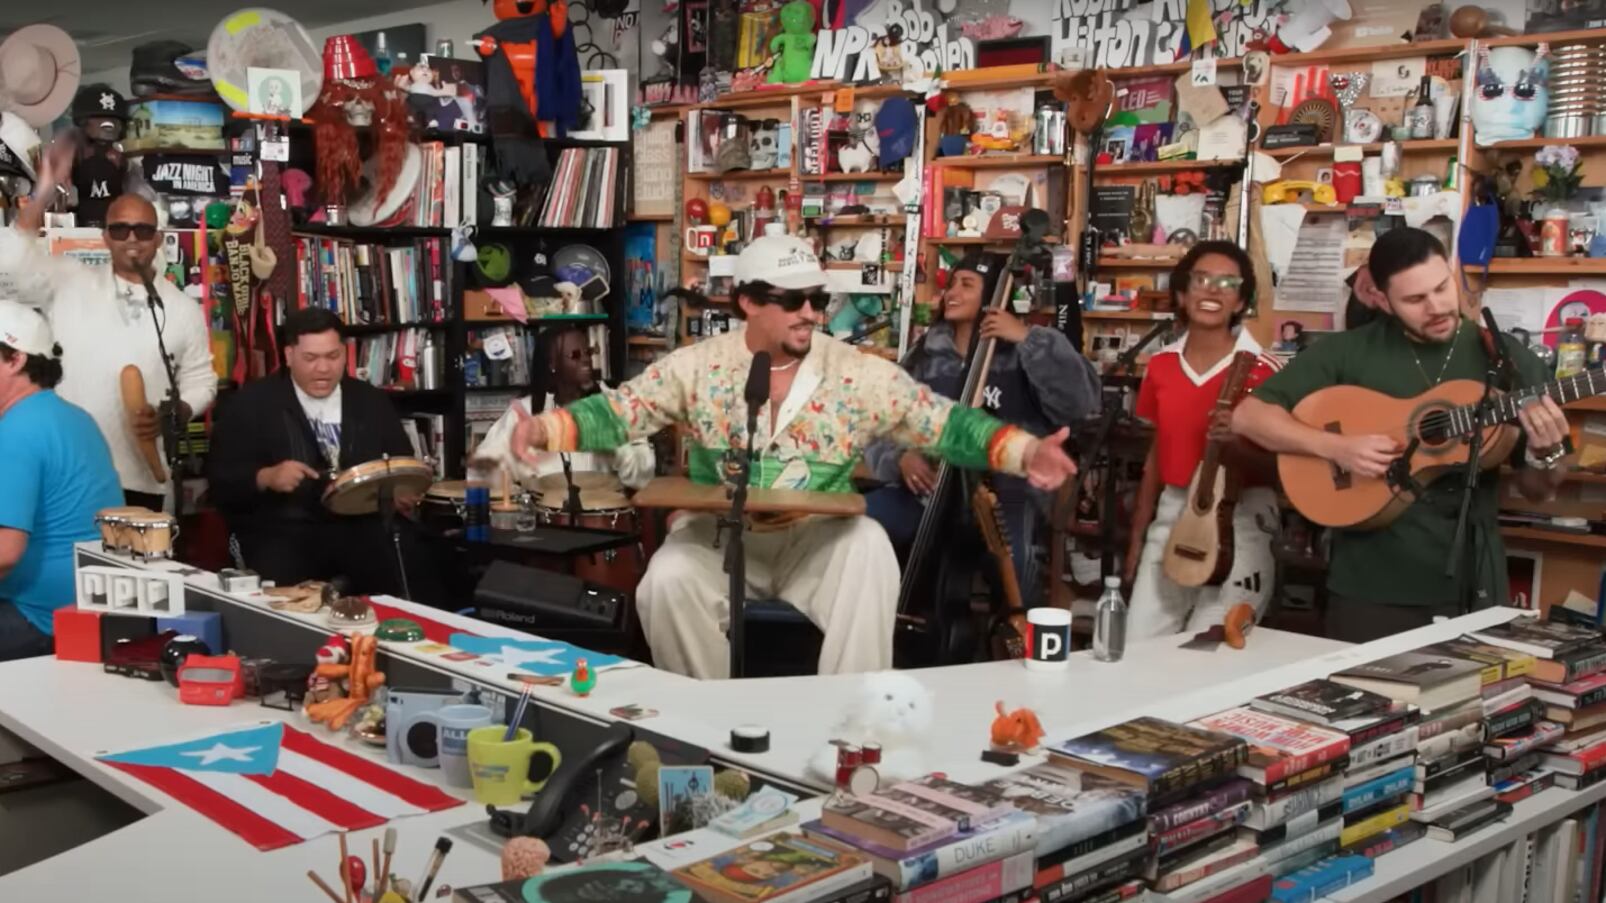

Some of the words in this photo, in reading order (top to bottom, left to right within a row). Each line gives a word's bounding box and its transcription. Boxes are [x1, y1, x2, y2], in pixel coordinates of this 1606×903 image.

[810, 25, 888, 82] NPR
[900, 23, 975, 76] Boilen
[1050, 16, 1150, 70] Hilton
[152, 162, 182, 181] JAZZ
[182, 163, 215, 183] NIGHT
[182, 180, 216, 193] AMERICA
[225, 239, 241, 282] BANJO
[239, 243, 251, 287] BLACK
[494, 608, 536, 625] Roland
[954, 838, 997, 863] DUKE
